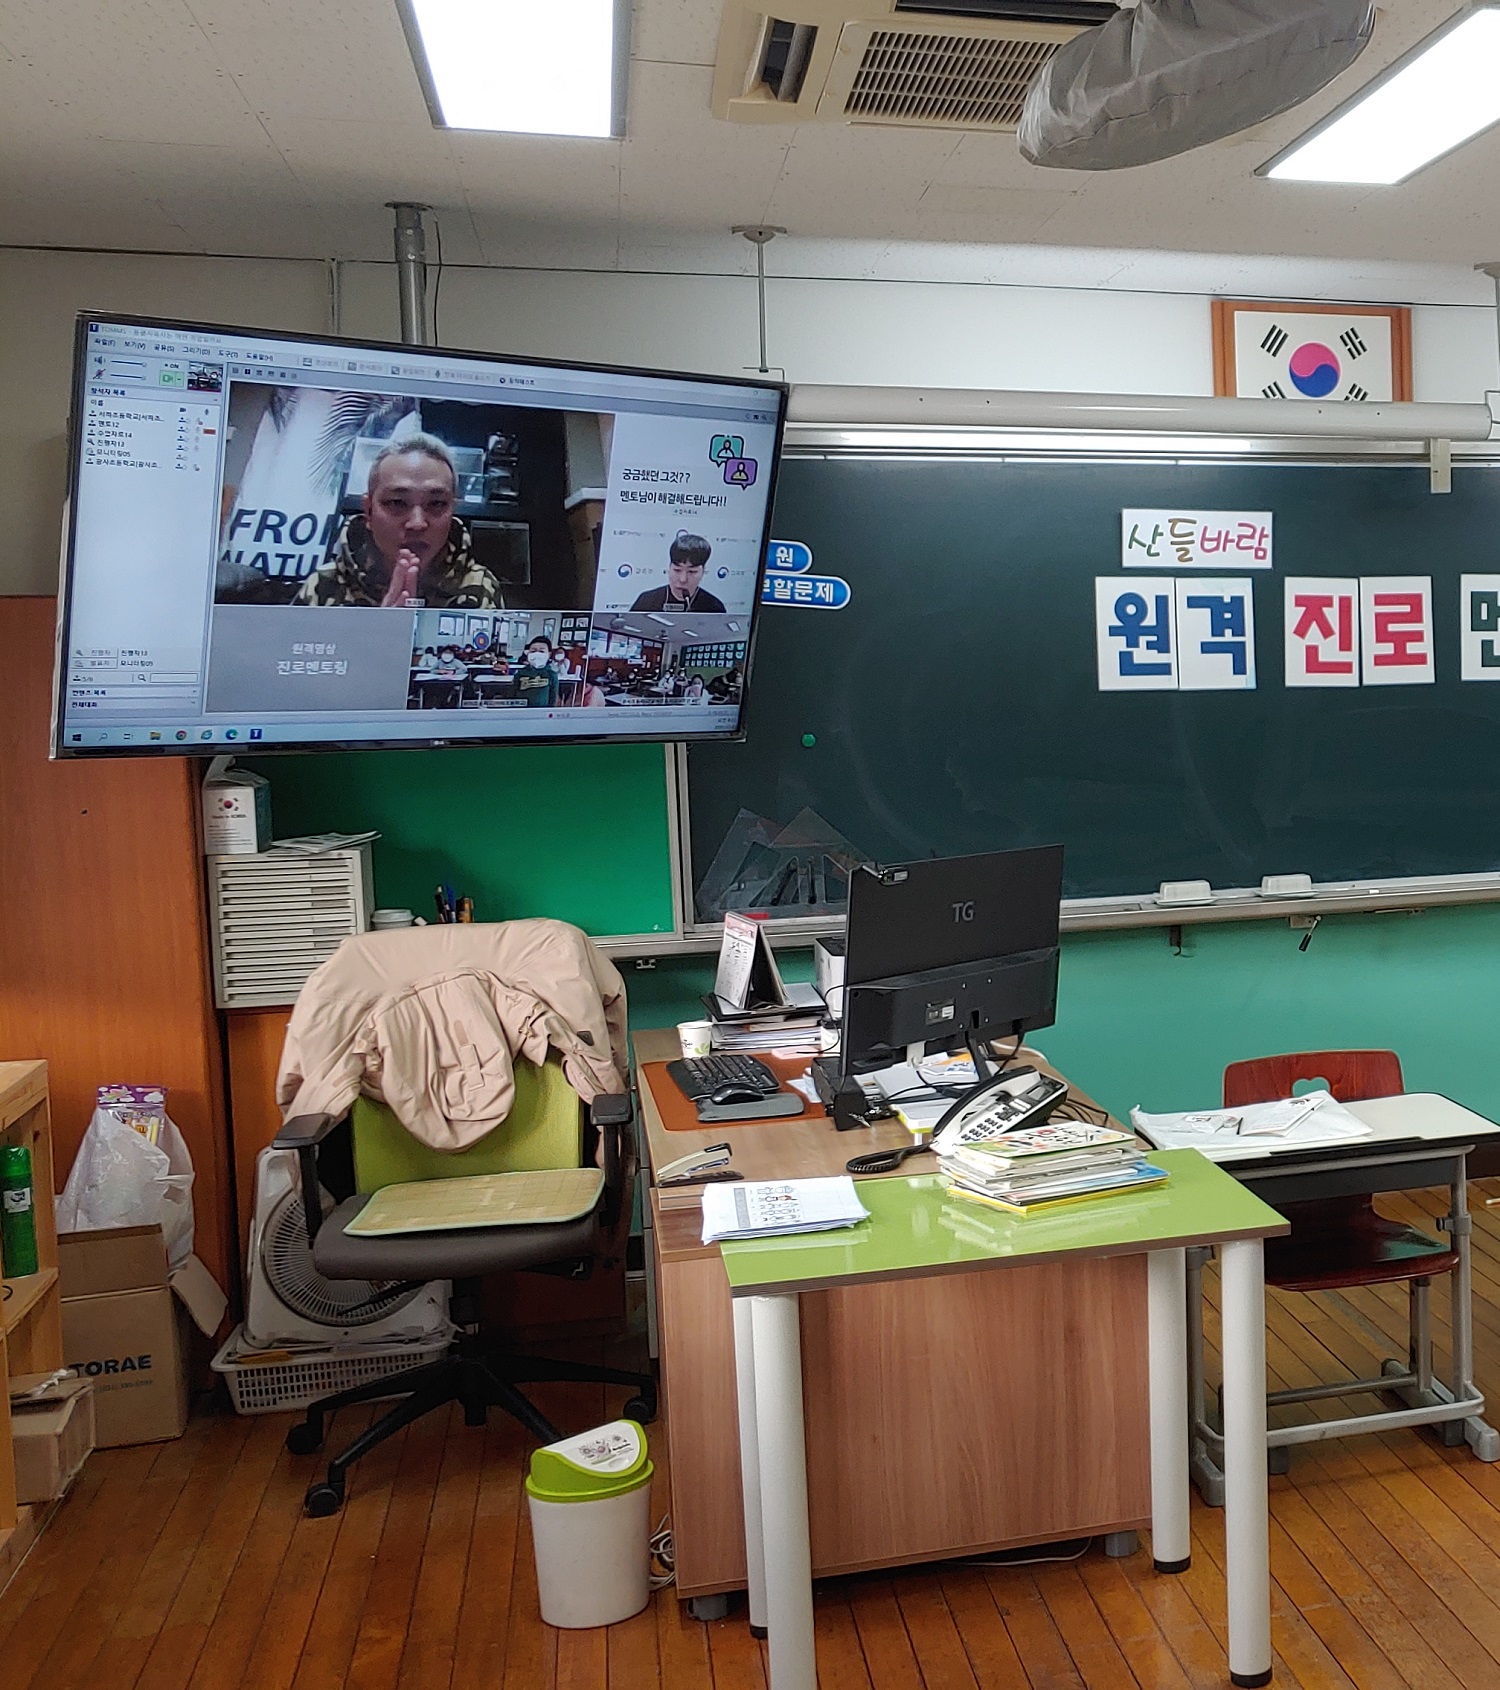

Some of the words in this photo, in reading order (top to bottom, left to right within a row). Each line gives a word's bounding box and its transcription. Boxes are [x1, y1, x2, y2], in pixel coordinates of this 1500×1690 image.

[622, 468, 659, 483] 궁금했던
[660, 470, 691, 483] 그것??
[619, 490, 656, 504] 멘토님이
[658, 492, 727, 507] 해결해드립니다!!
[1127, 516, 1270, 563] 산들바람
[775, 546, 794, 568] 원
[1107, 591, 1248, 677] 원격
[1291, 591, 1429, 674] 진로
[291, 642, 337, 656] 원격영상
[276, 660, 348, 676] 진로멘토링
[952, 901, 974, 923] TG
[68, 1354, 152, 1378] TORAE
